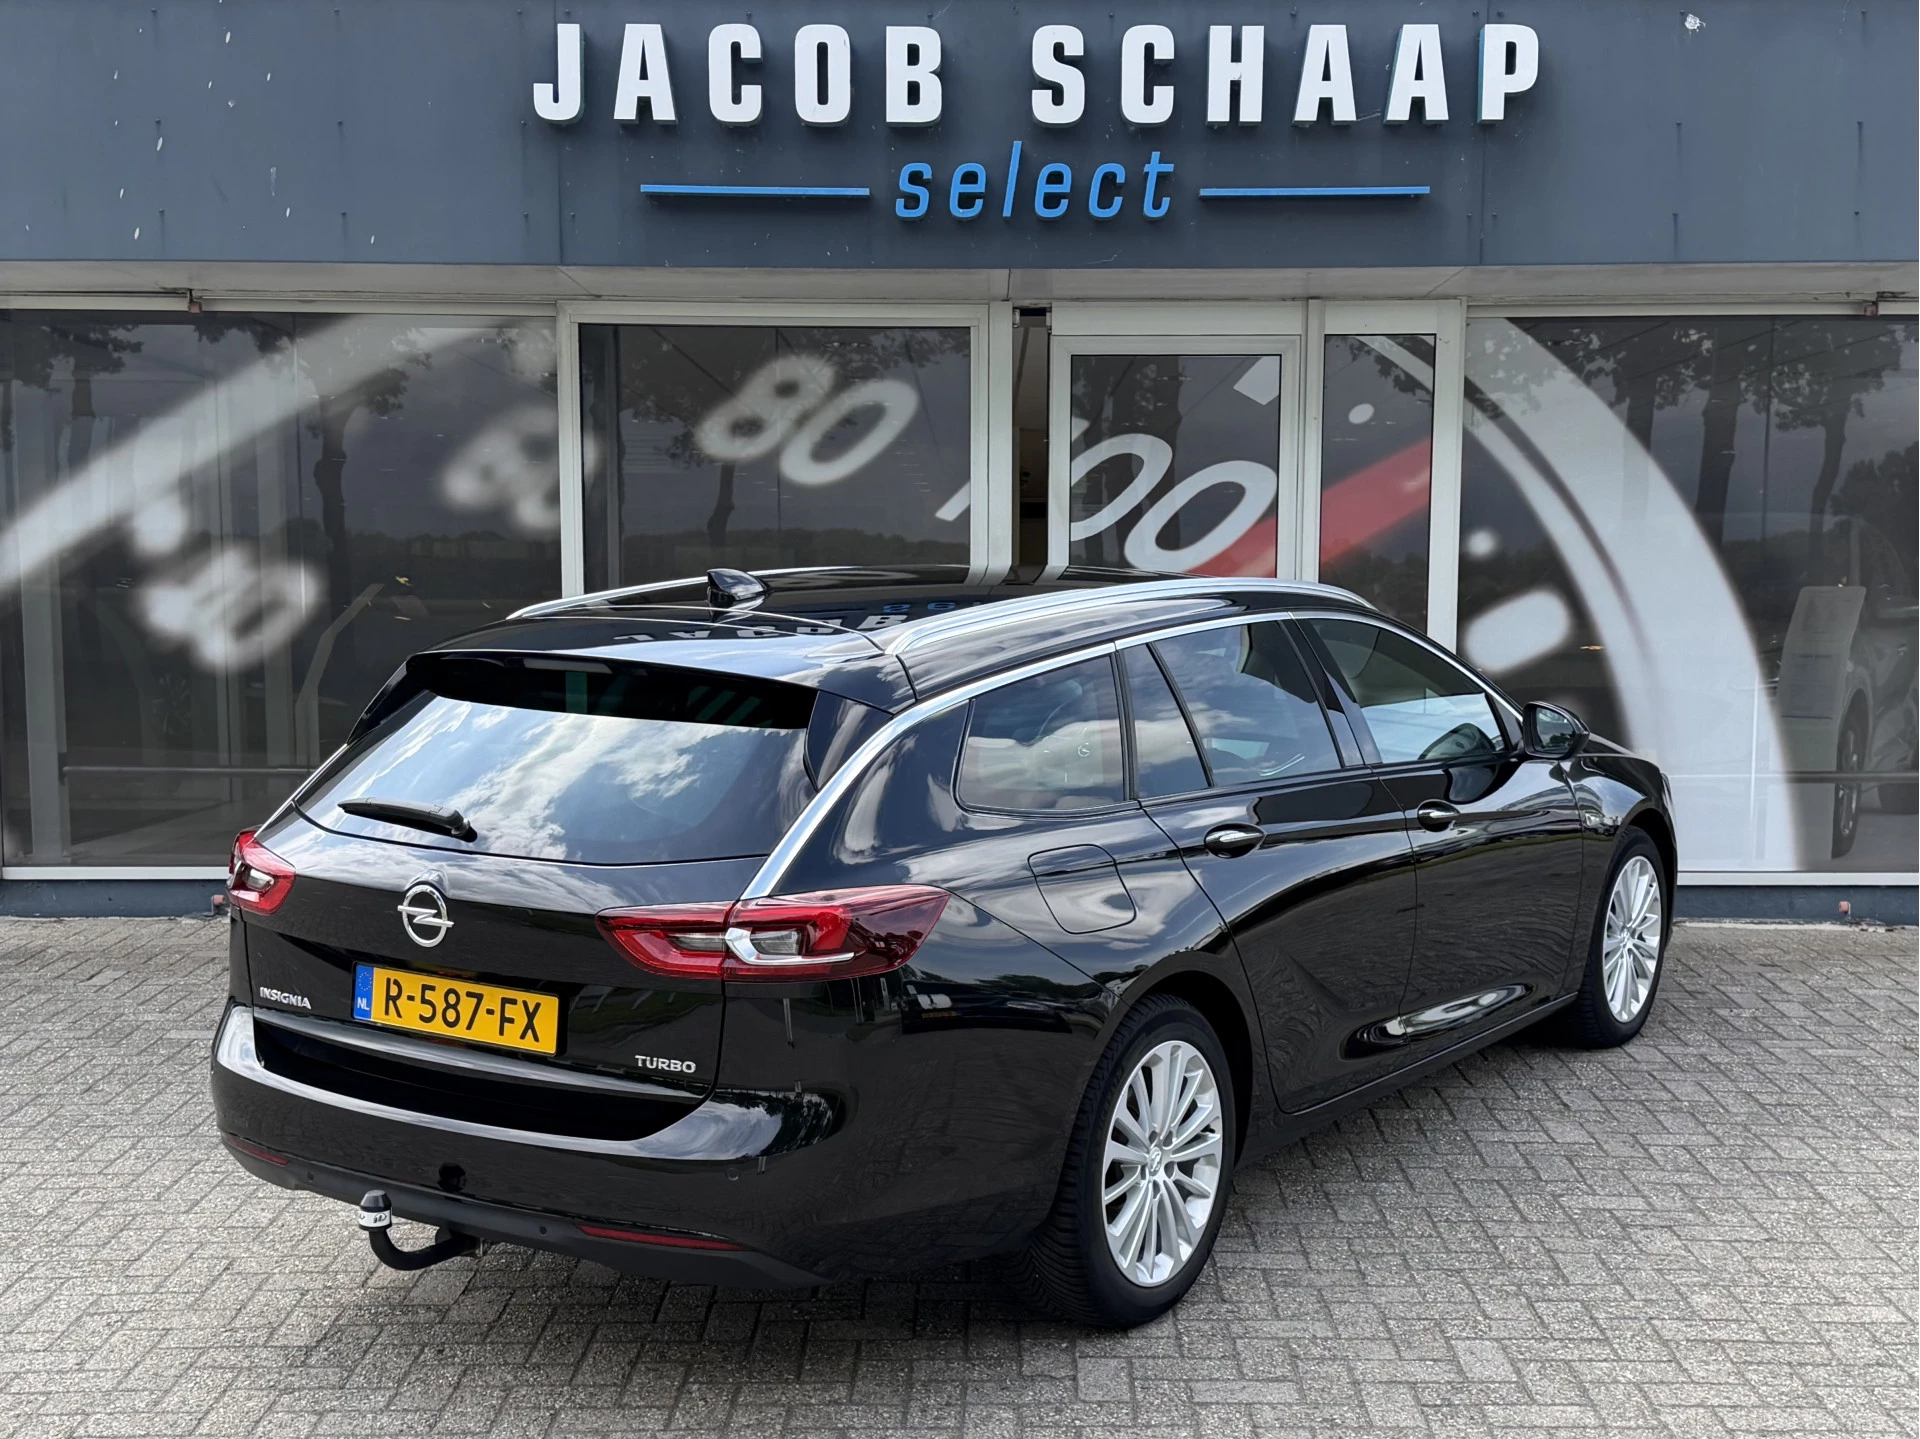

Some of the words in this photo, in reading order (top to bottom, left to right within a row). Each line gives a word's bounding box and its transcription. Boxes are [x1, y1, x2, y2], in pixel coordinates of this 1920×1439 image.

[533, 23, 944, 126] JACOB
[1030, 23, 1540, 126] SCHAAP
[894, 140, 1176, 221] select
[698, 354, 919, 487] 80
[259, 986, 312, 1010] INSIGNIA
[357, 996, 370, 1011] NL
[384, 976, 542, 1043] R-587-FX
[634, 1054, 697, 1074] TURBO
